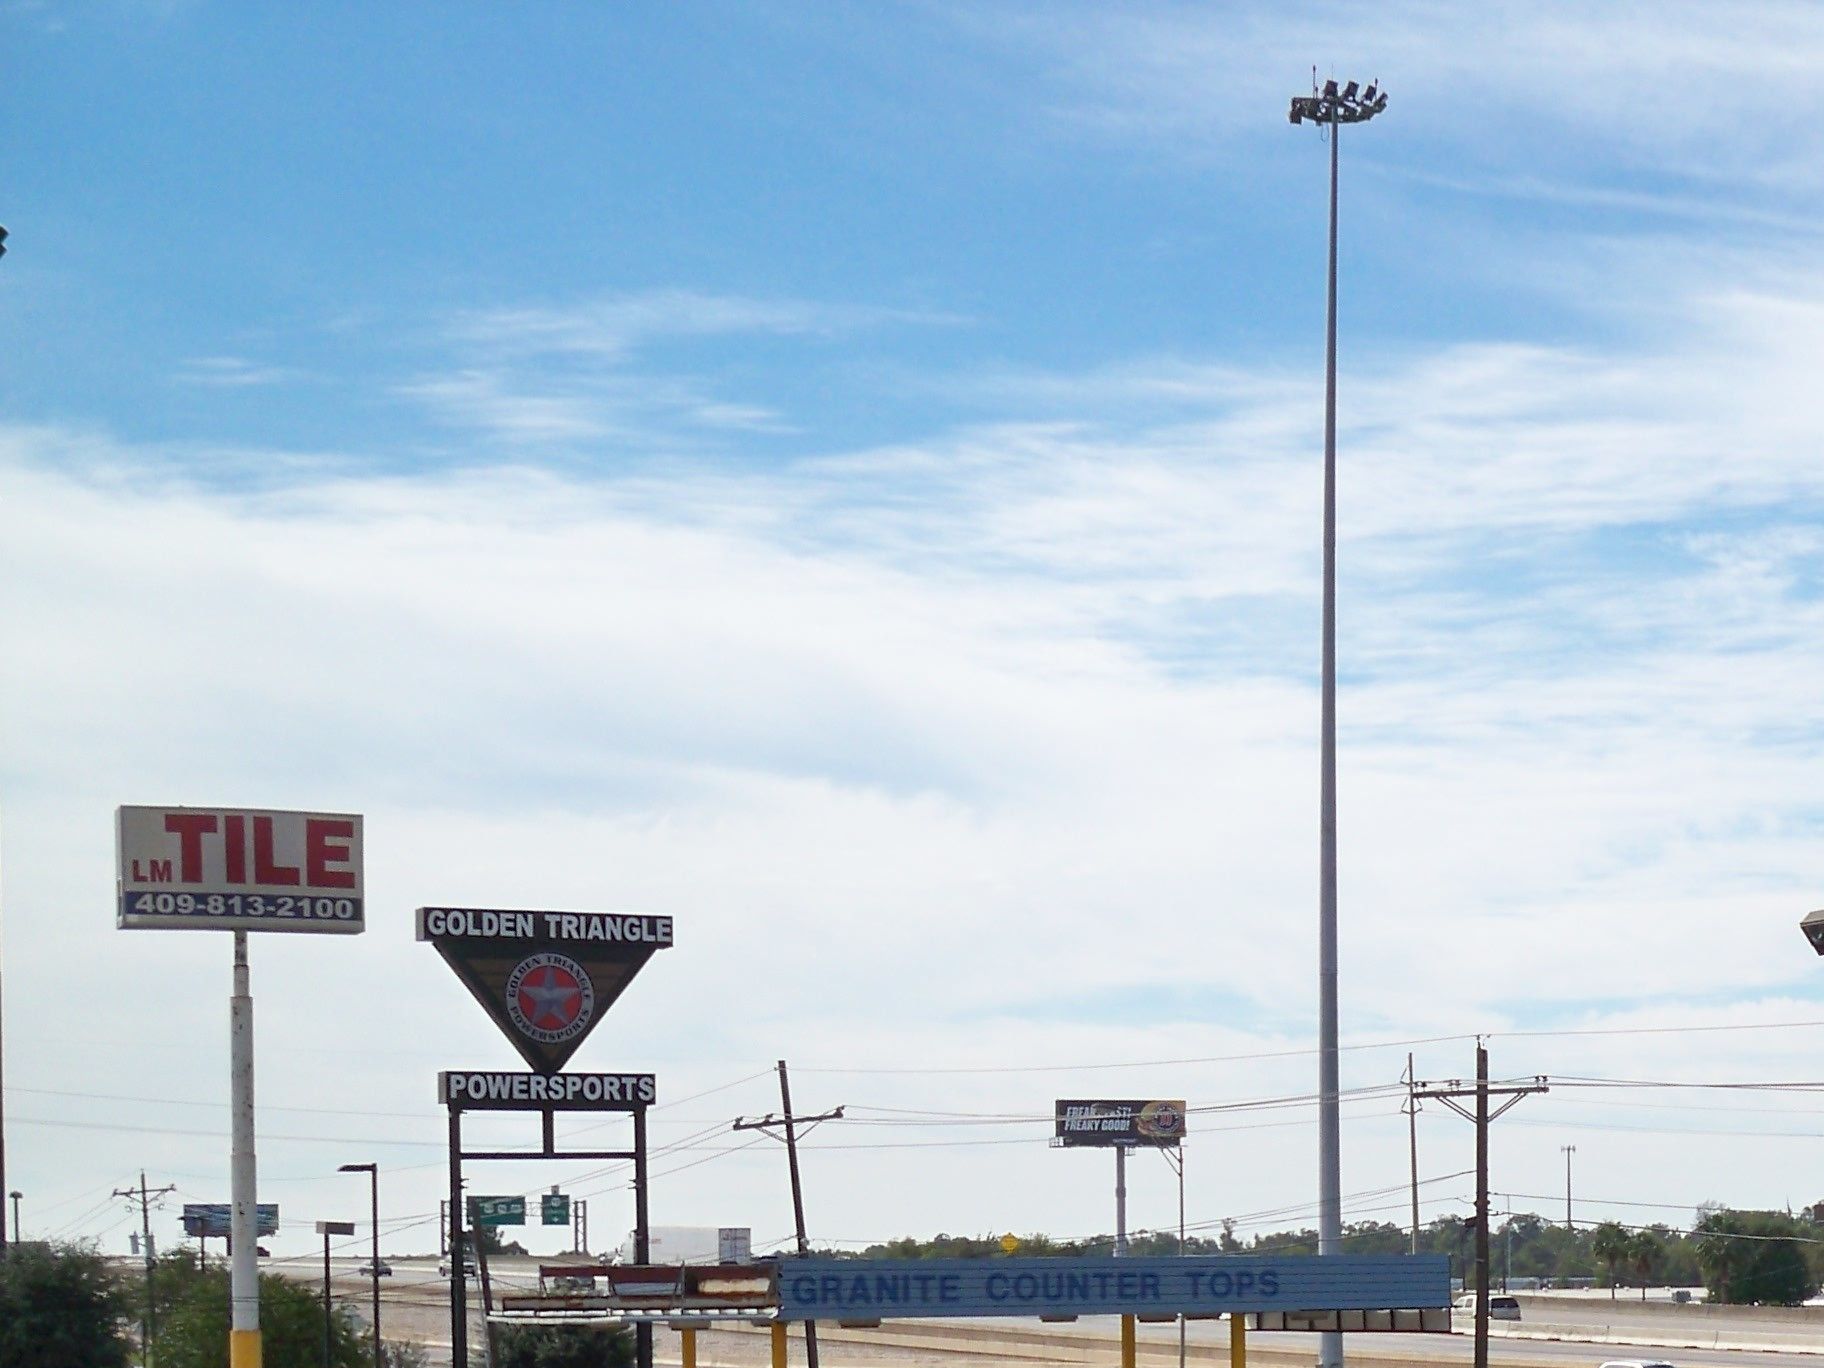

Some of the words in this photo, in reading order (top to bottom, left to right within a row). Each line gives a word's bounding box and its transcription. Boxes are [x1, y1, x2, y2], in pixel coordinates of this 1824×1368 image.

[132, 859, 172, 883] LM
[165, 814, 355, 889] TILE
[135, 893, 354, 919] 409-813-2100
[427, 910, 534, 938] GOLDEN
[544, 913, 672, 942] TRIANGLE
[510, 1005, 589, 1041] POWERSPORTS
[451, 1074, 655, 1101] POWERSPORTS
[1064, 1119, 1100, 1131] FREAKY
[1101, 1119, 1131, 1131] GOOD!
[790, 1272, 960, 1304] GRANITE
[985, 1271, 1161, 1302] COUNTER
[1185, 1269, 1280, 1299] TOPS
